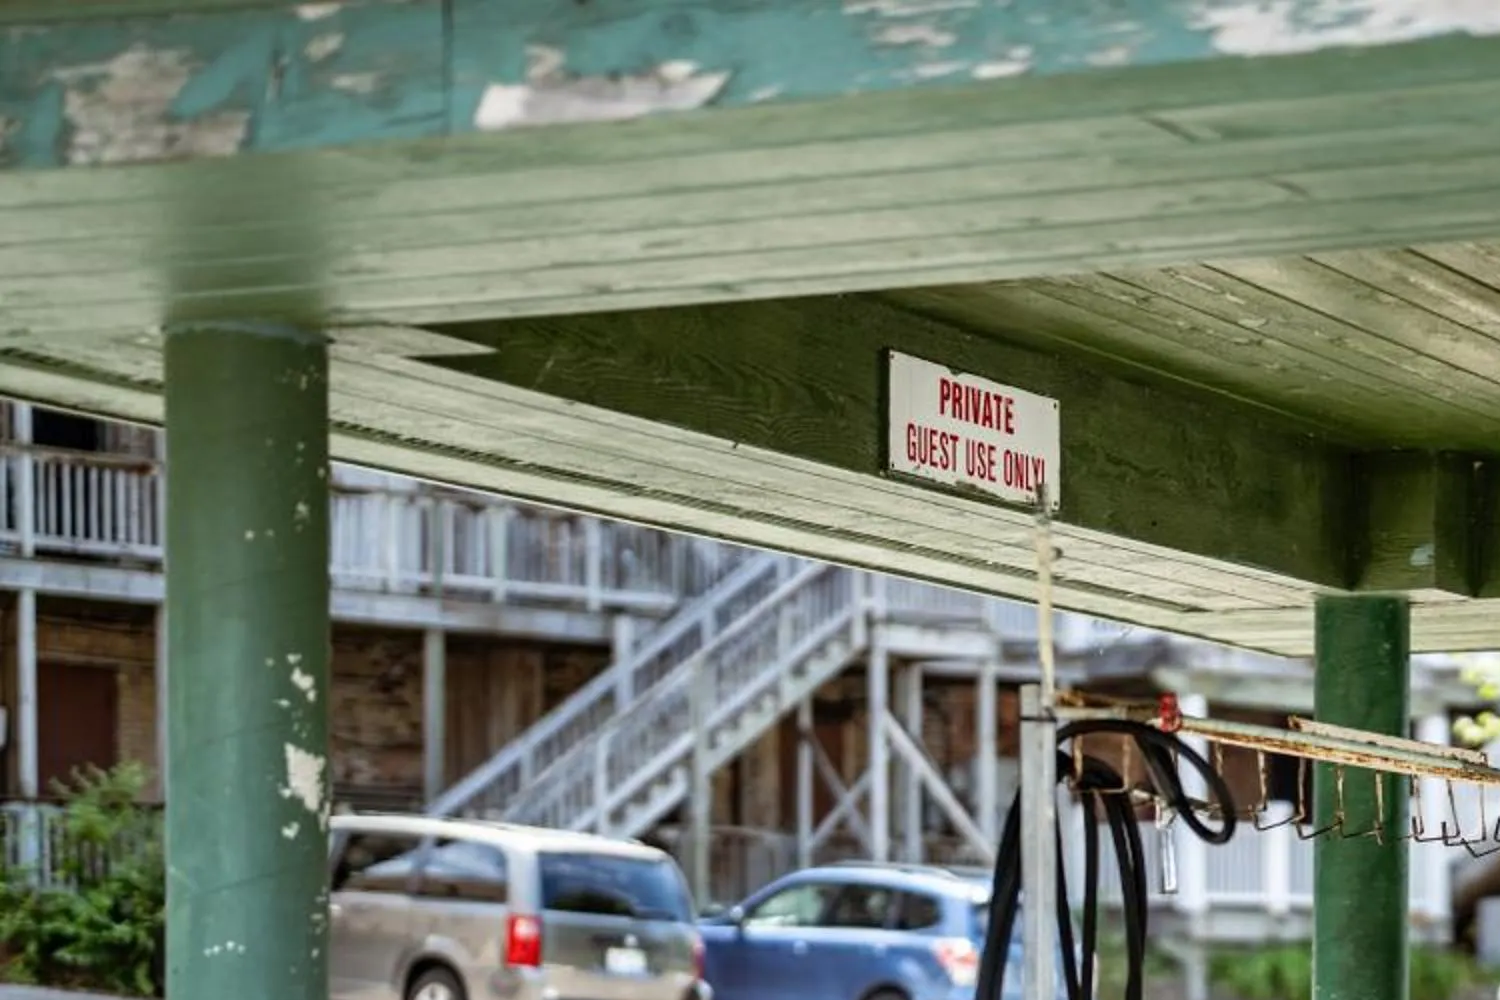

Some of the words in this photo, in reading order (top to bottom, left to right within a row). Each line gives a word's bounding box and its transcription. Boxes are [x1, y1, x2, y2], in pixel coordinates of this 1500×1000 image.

[940, 378, 1015, 435] PRIVATE
[907, 423, 959, 472] GUEST
[965, 438, 997, 482] USE
